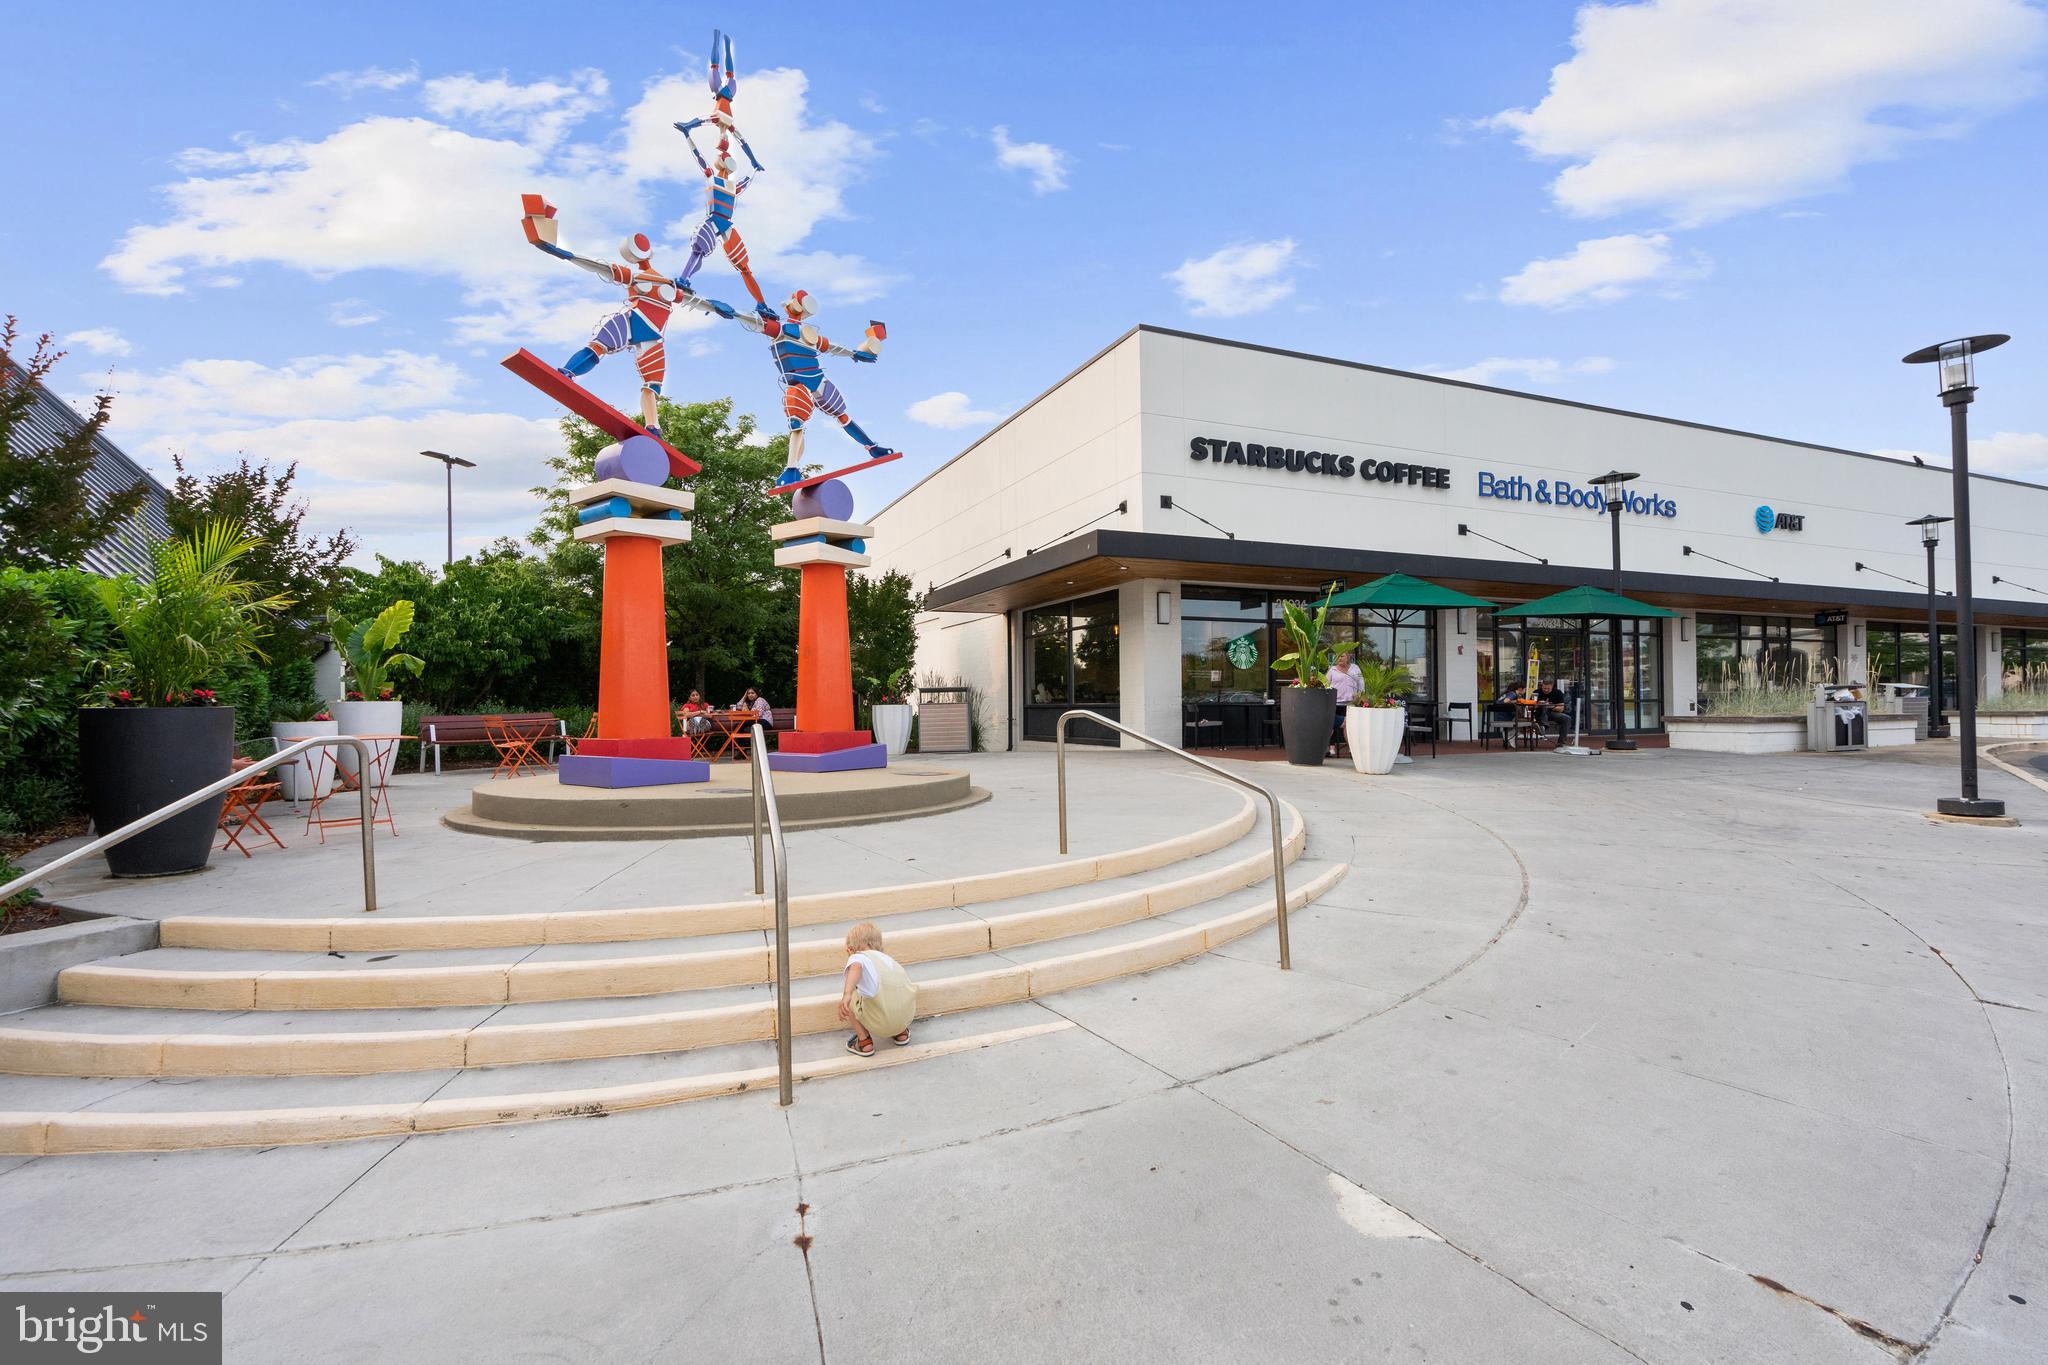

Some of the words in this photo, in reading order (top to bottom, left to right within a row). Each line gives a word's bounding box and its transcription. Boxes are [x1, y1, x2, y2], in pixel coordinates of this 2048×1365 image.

[1190, 436, 1355, 478] STARBUCKS
[1359, 458, 1450, 489] COFFEE
[1478, 471, 1532, 501] Bath
[1535, 479, 1552, 504] &
[1555, 481, 1607, 515] Body
[1774, 513, 1805, 531] AT&T
